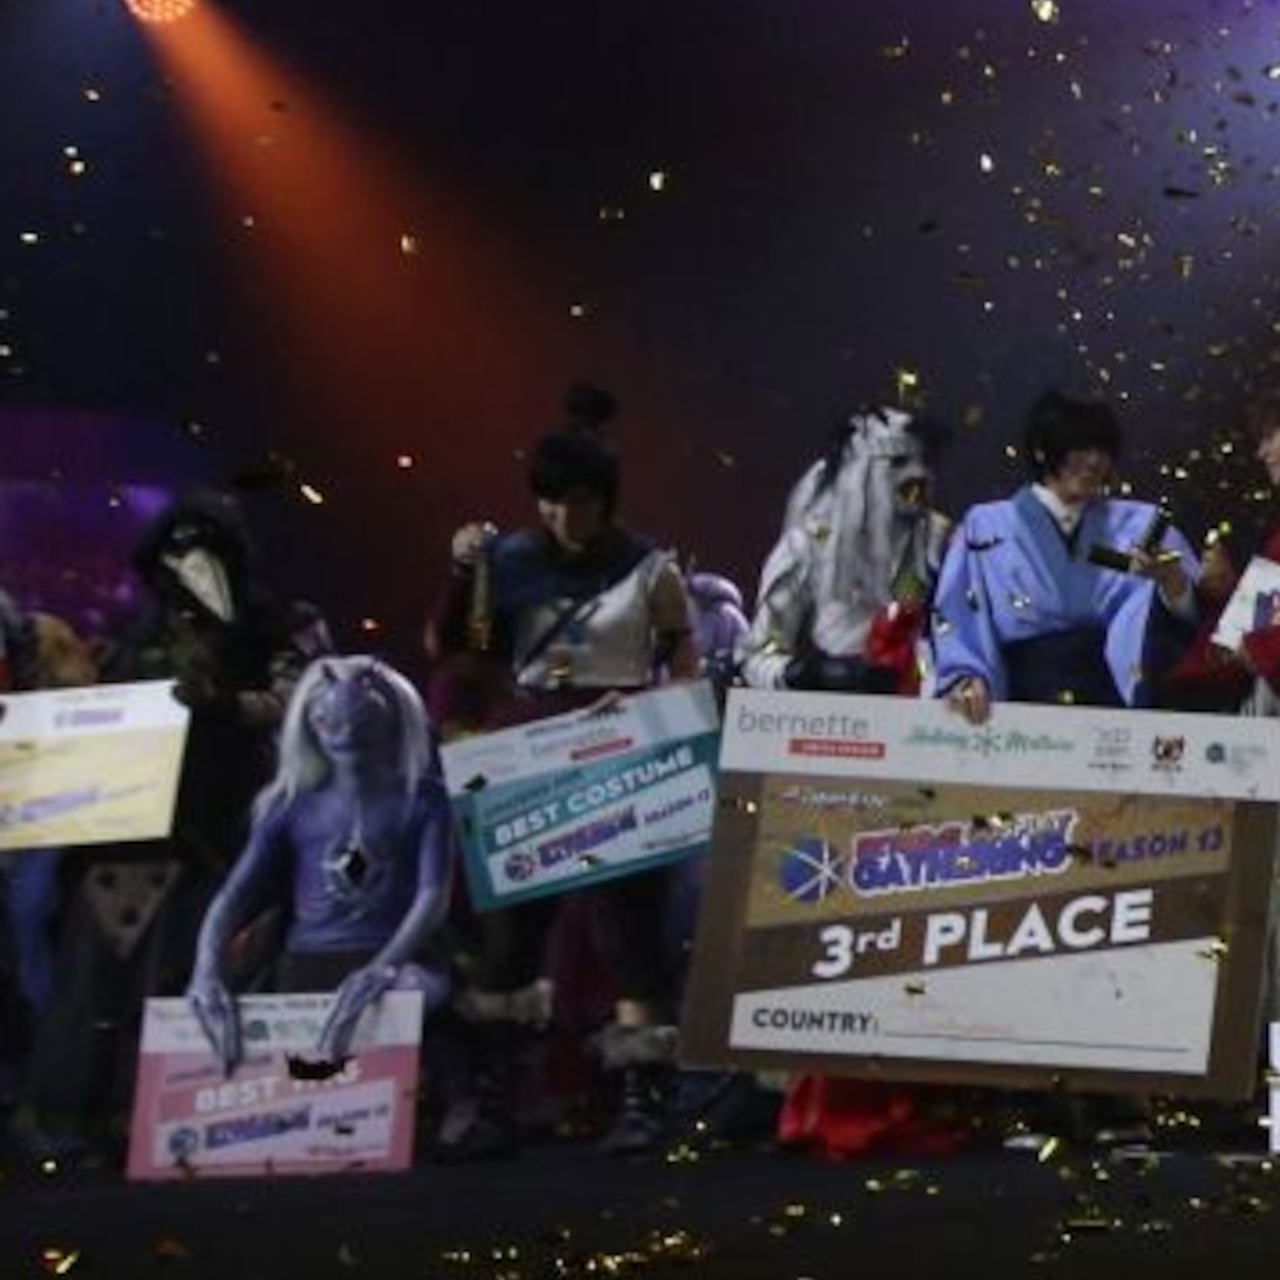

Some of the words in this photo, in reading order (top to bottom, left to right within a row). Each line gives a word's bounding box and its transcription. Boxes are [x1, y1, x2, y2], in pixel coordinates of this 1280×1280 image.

[737, 703, 869, 739] bernette
[495, 804, 561, 846] BEST
[567, 745, 694, 813] COSTUME
[811, 918, 901, 979] 3rd
[923, 889, 1154, 966] PLACE
[752, 1008, 879, 1036] COUNTRY:
[195, 1082, 276, 1112] BEST
